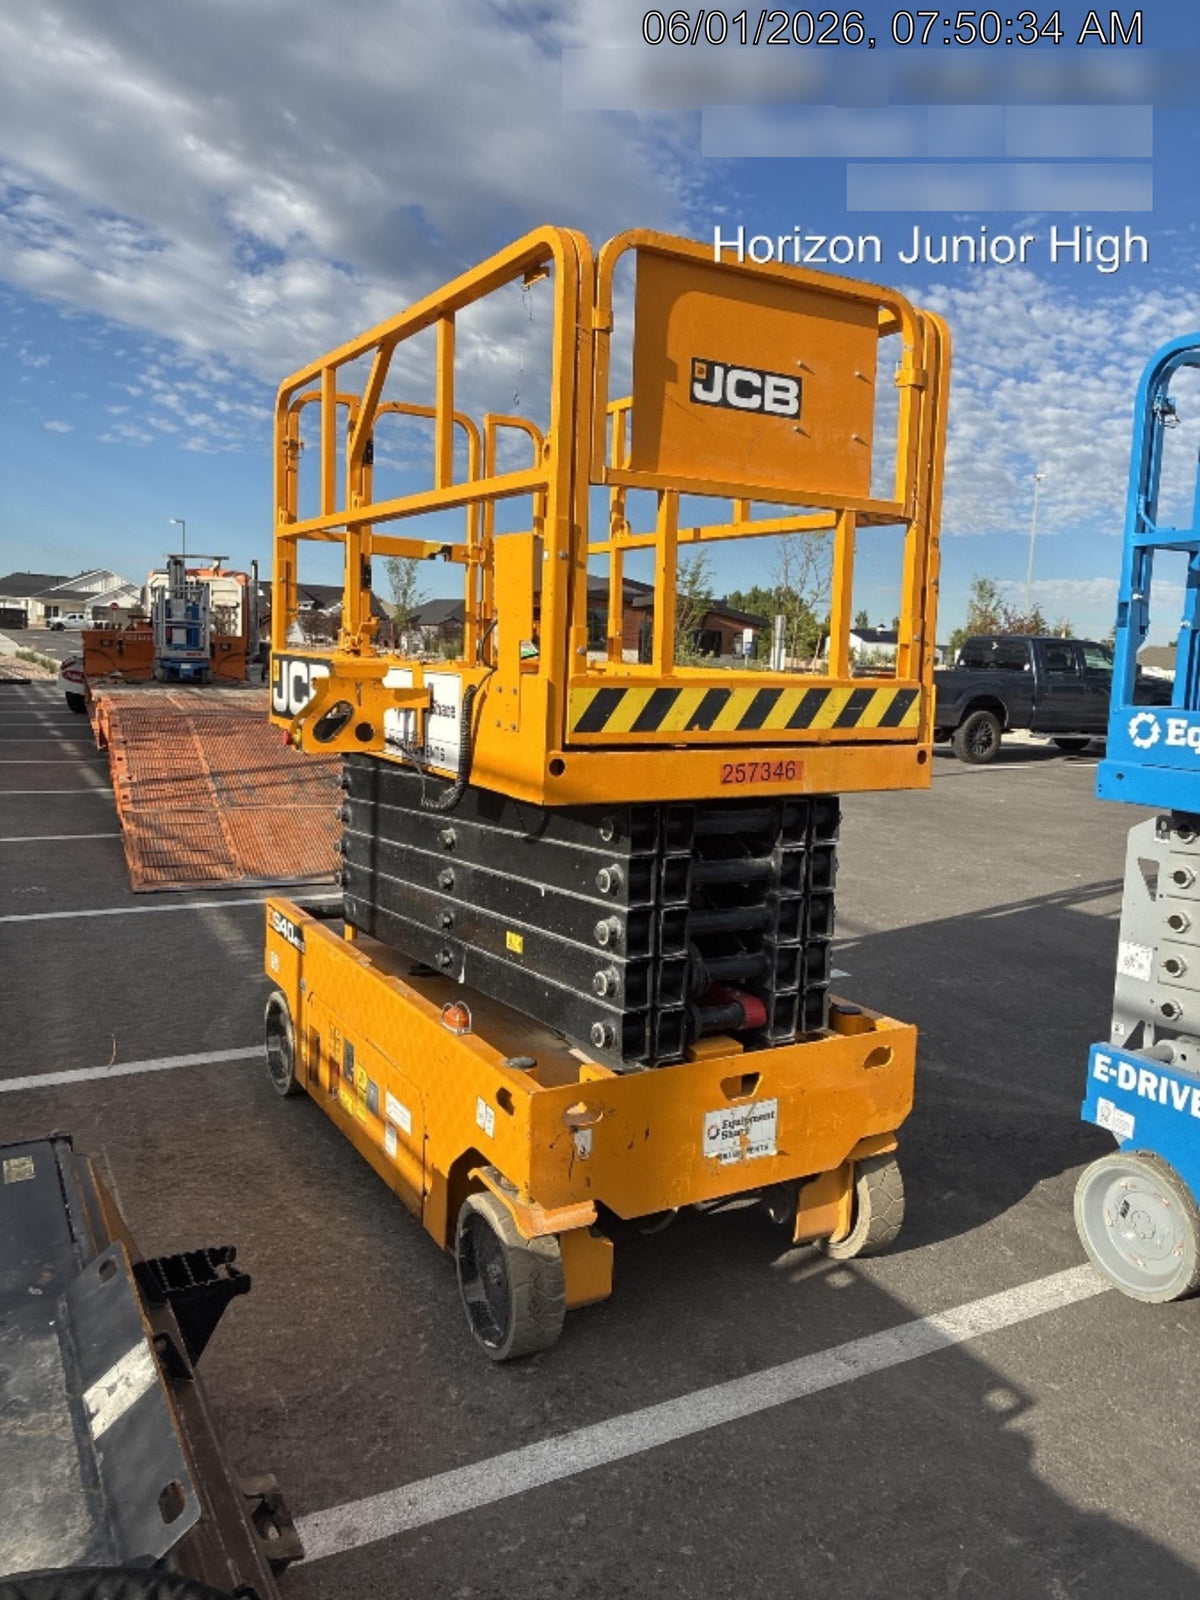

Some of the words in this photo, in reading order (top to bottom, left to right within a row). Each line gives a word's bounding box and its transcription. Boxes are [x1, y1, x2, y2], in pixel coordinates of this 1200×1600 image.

[693, 365, 799, 415] JCB
[721, 760, 796, 785] 257346
[721, 1110, 775, 1130] Equipment
